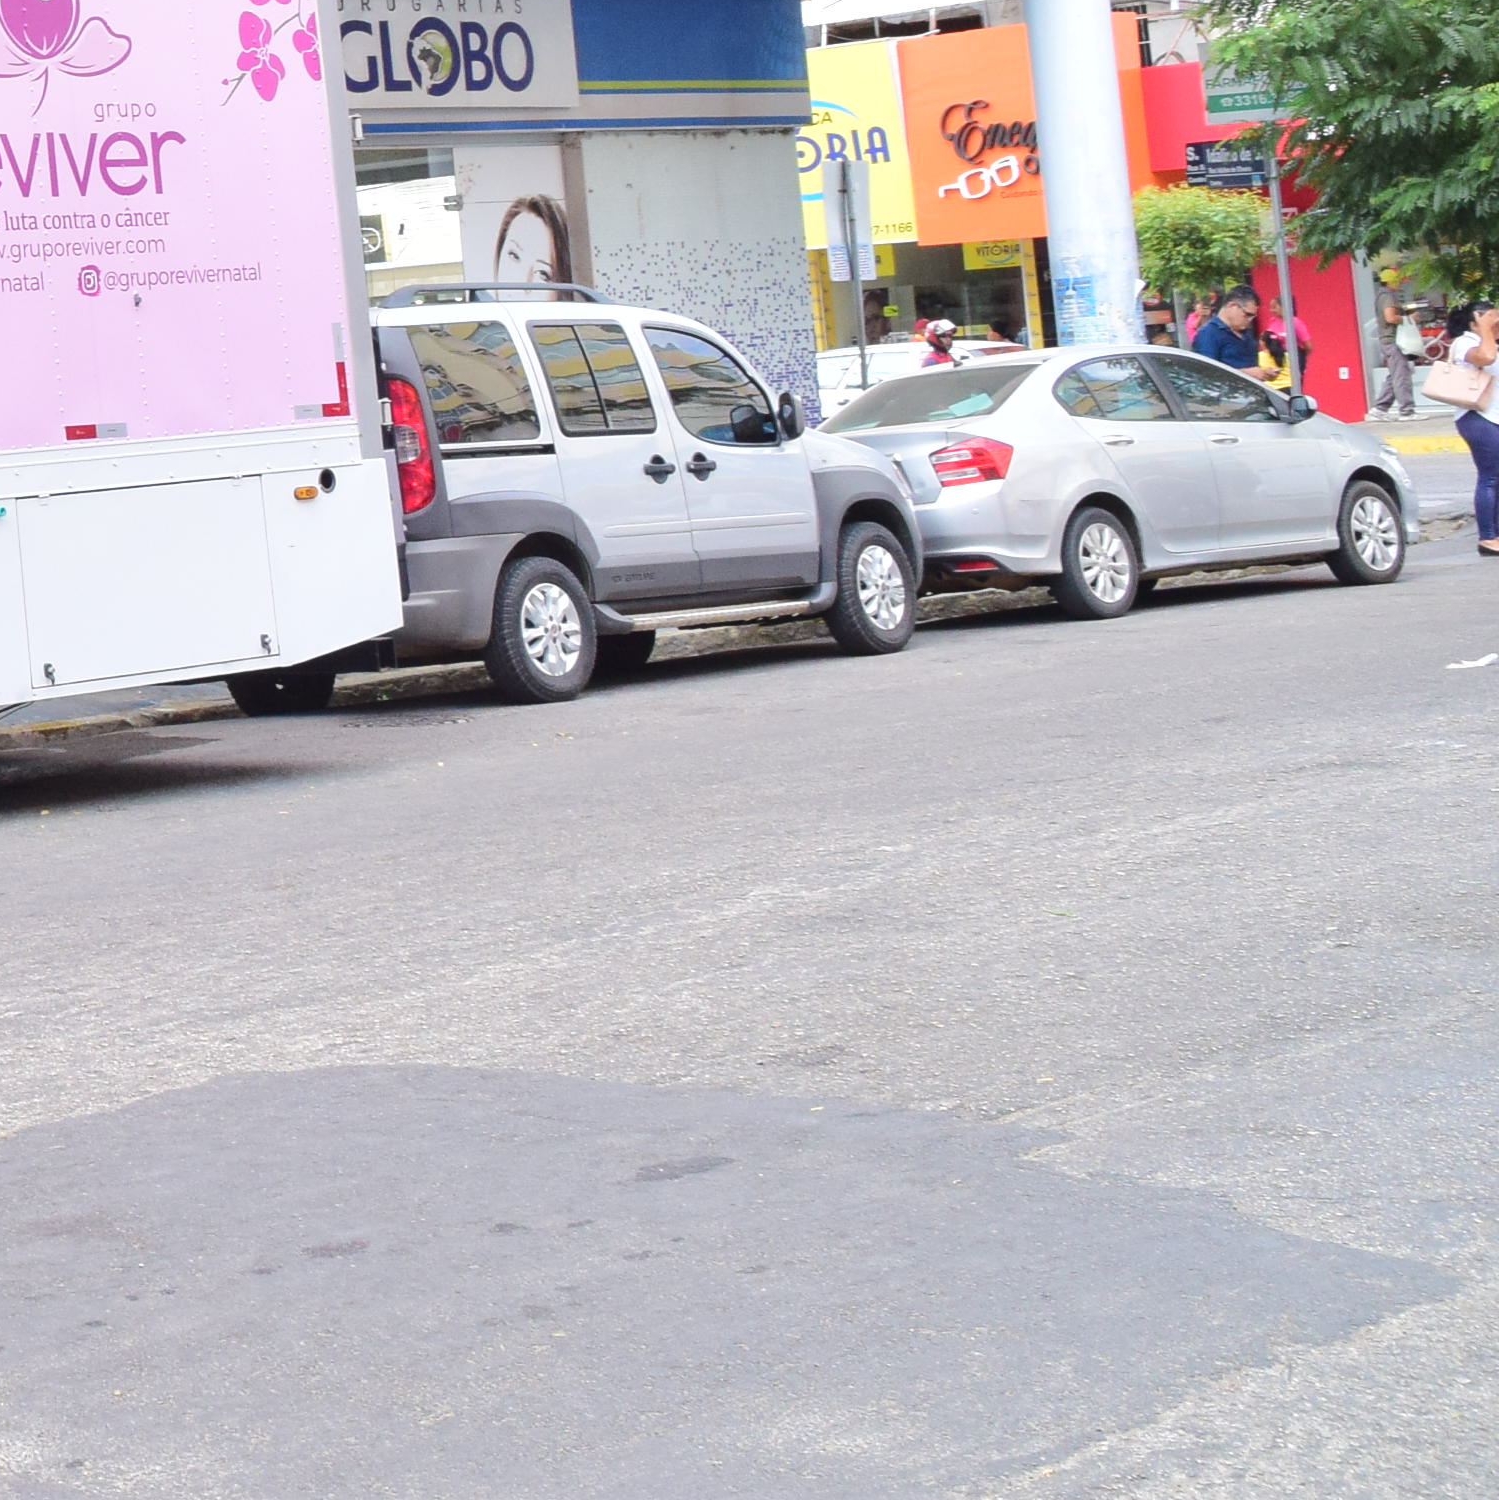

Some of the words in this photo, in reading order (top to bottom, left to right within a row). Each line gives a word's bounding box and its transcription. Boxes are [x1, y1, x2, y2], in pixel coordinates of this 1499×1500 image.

[340, 16, 534, 97] GLOBO
[94, 102, 157, 122] grupo
[4, 210, 39, 231] luta
[42, 211, 97, 230] contra
[100, 213, 111, 228] o
[115, 207, 170, 228] câncer
[104, 263, 262, 291] @gruporevivernatal
